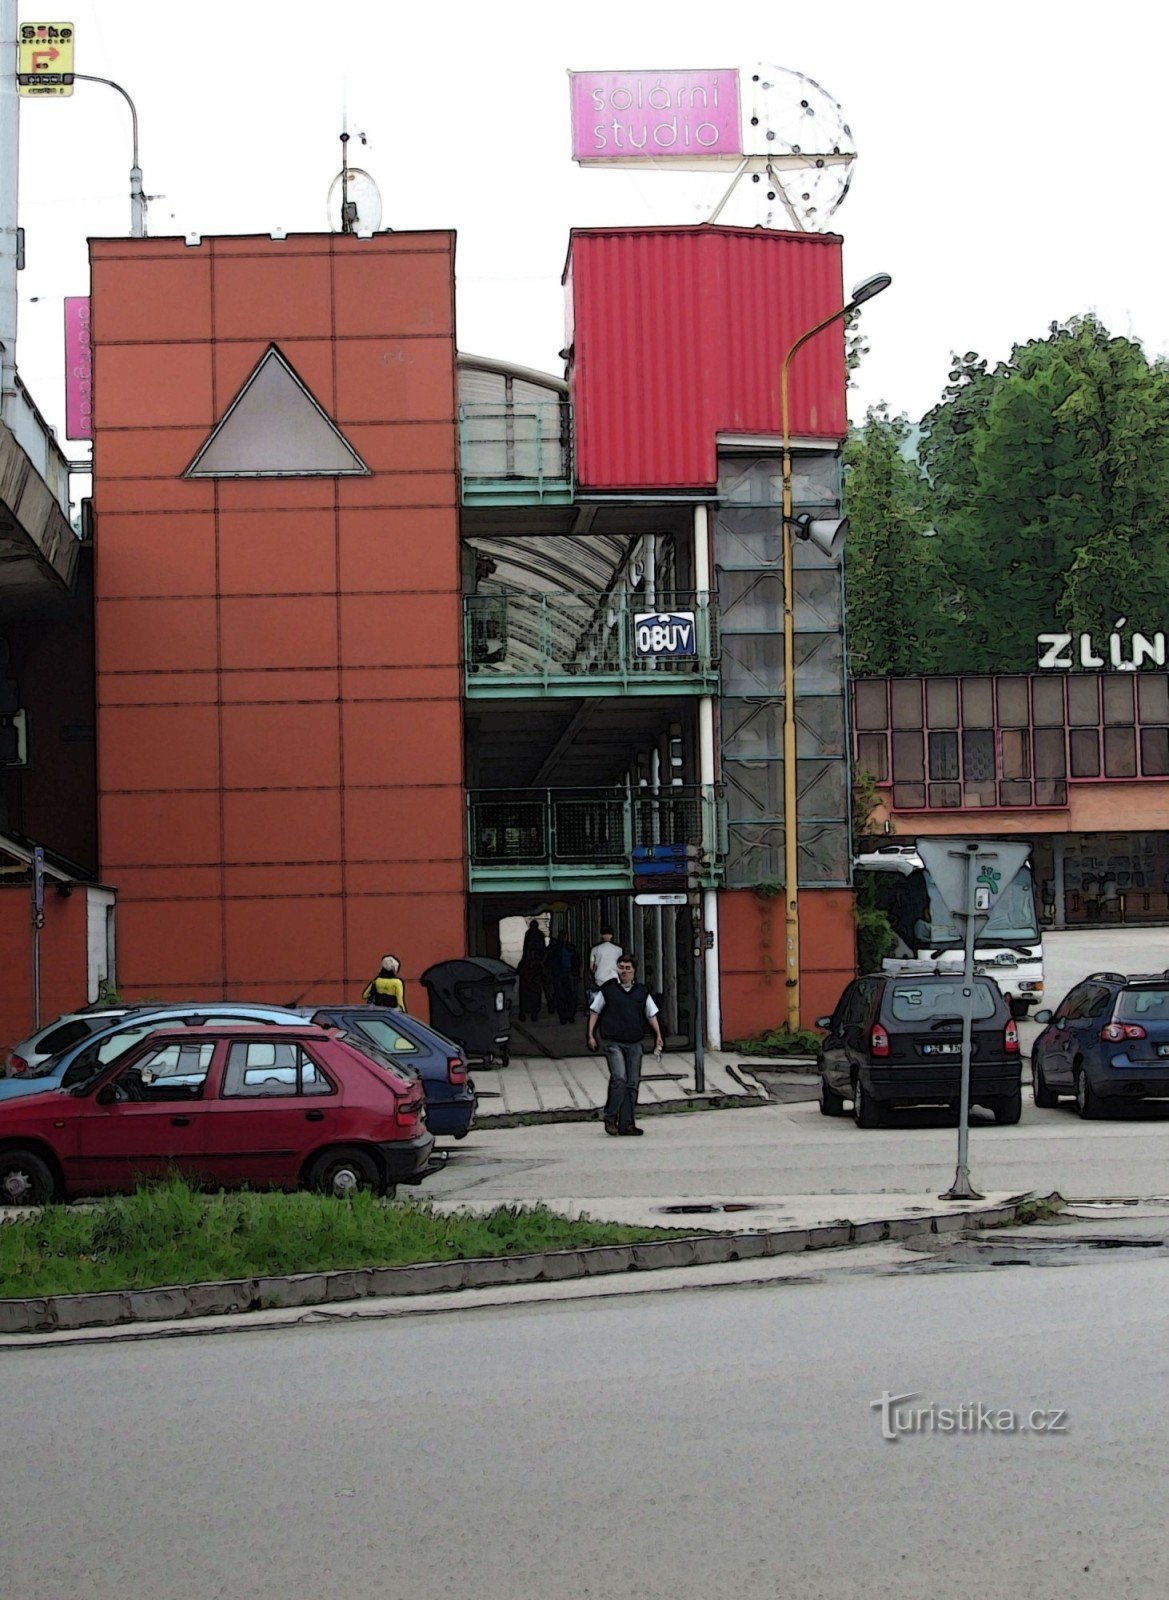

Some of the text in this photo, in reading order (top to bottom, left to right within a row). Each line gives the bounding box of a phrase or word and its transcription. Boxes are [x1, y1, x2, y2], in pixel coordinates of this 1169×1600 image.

[592, 77, 718, 111] solární
[594, 116, 719, 149] studio
[639, 624, 691, 652] OBUV
[1037, 617, 1165, 668] ZLÍN
